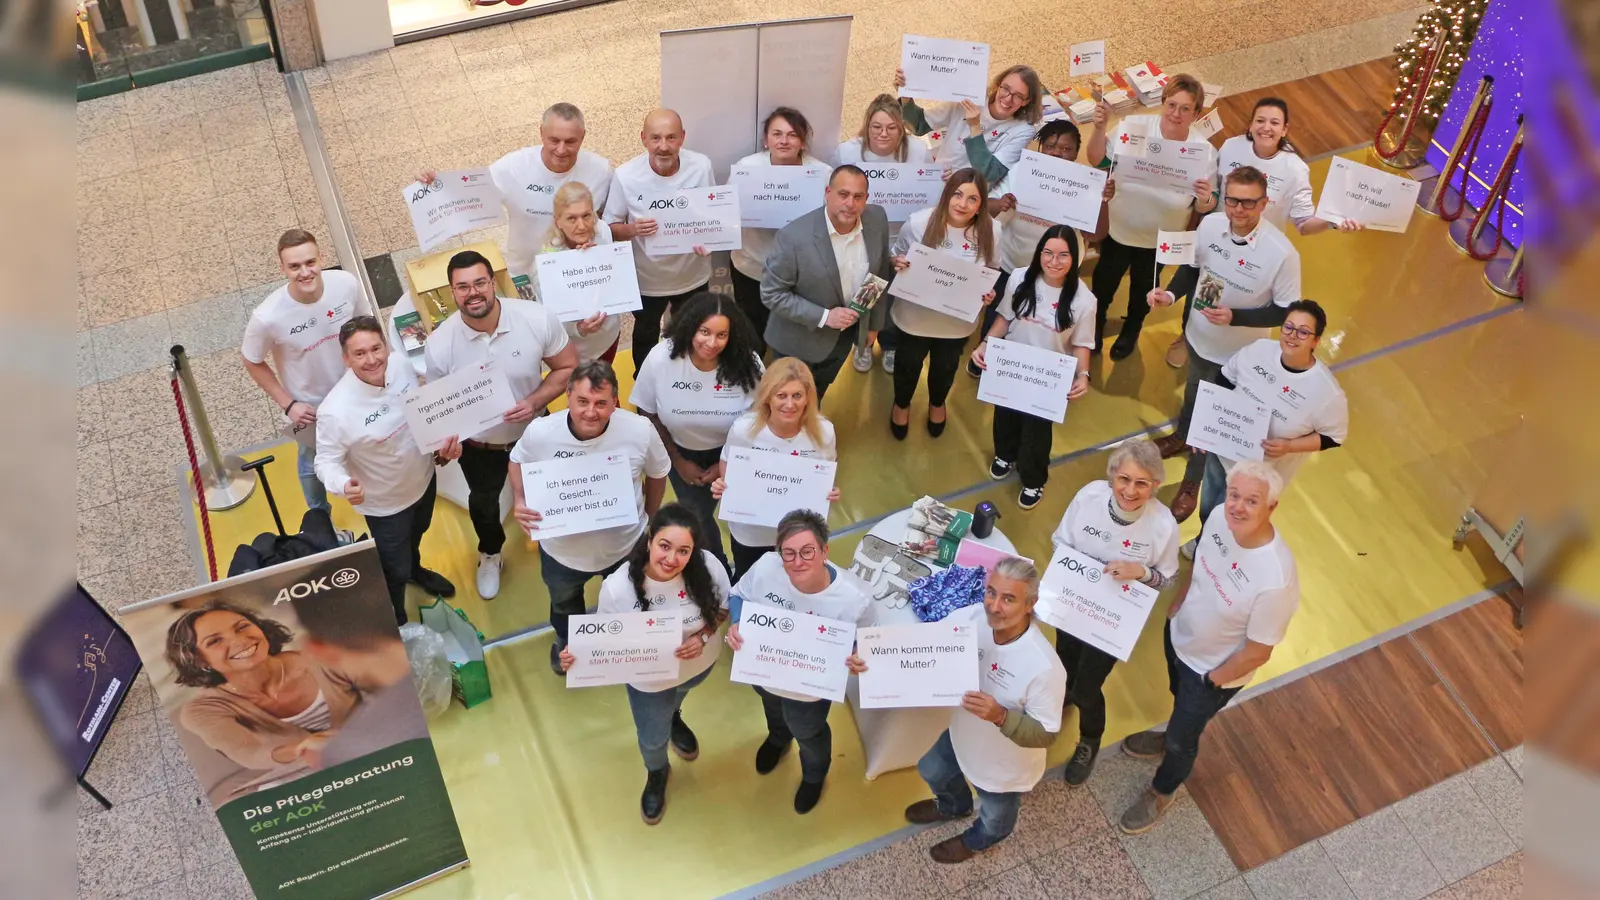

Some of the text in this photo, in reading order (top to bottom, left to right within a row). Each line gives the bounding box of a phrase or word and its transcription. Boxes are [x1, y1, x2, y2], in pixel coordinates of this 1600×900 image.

[910, 52, 930, 60] Wann
[958, 57, 980, 66] meine
[930, 65, 958, 74] Mutter?
[1148, 162, 1174, 171] machen
[1031, 168, 1089, 190] Warum vergesse
[1162, 171, 1188, 180] Demenz
[412, 183, 430, 204] AOK
[526, 184, 544, 192] AOK
[1062, 189, 1078, 198] viel?
[1358, 182, 1369, 190] Ich
[649, 199, 674, 210] AOK
[1346, 190, 1391, 208] nach Hause!
[427, 207, 438, 218] Wir
[439, 200, 465, 211] machen
[429, 203, 484, 224] stark für Demenz
[1208, 243, 1223, 254] AOK
[562, 263, 613, 278] Habe ich das
[927, 264, 956, 280] Kennen
[567, 275, 612, 290] vergessen?
[935, 278, 954, 288] uns?
[290, 322, 308, 335] AOK
[996, 356, 1020, 369] Irgend
[1022, 363, 1034, 372] wie
[1045, 369, 1062, 379] alles
[1253, 365, 1268, 378] AOK
[996, 369, 1023, 382] gerade
[672, 382, 692, 390] AOK
[418, 377, 493, 415] Irgend wie ist alles
[425, 390, 494, 425] gerade anders...!
[1212, 402, 1254, 424] Ich kenne dein
[365, 410, 381, 427] AOK
[1203, 425, 1218, 435] aber
[1232, 435, 1242, 444] bist
[1243, 440, 1254, 449] du?
[547, 473, 609, 489] Ich kenne dein
[754, 470, 803, 484] Kennen wir
[559, 489, 600, 501] Gesicht...
[767, 486, 788, 496] uns?
[545, 498, 618, 517] aber wer bist du?
[1082, 525, 1102, 538] AOK
[1212, 533, 1223, 548] AOK
[1058, 557, 1087, 576] AOK
[273, 577, 331, 606] AOK
[764, 592, 785, 606] AOK
[1062, 586, 1122, 621] Wir machen uns
[746, 613, 777, 629] AOK
[1076, 604, 1087, 614] für
[1088, 609, 1119, 629] Demenz
[575, 623, 606, 634] AOK
[608, 648, 641, 656] machen
[759, 644, 826, 664] Wir machen uns
[871, 645, 964, 656] Wann kommt meine
[625, 655, 659, 663] Demenz
[756, 654, 776, 662] stark
[792, 660, 826, 673] Demenz
[900, 659, 936, 669] Mutter?
[243, 755, 414, 820] Die Pflegeberatung
[249, 800, 326, 834] der AOK
[256, 799, 377, 846] Kompetente Unterstützung von
[260, 839, 290, 852] Anfang
[290, 833, 302, 841] an
[309, 816, 349, 835] individuell
[350, 810, 365, 819] und
[366, 795, 405, 814] praxisnah
[278, 837, 409, 890] AOK Bayern. Die Gesundheitskasse.
